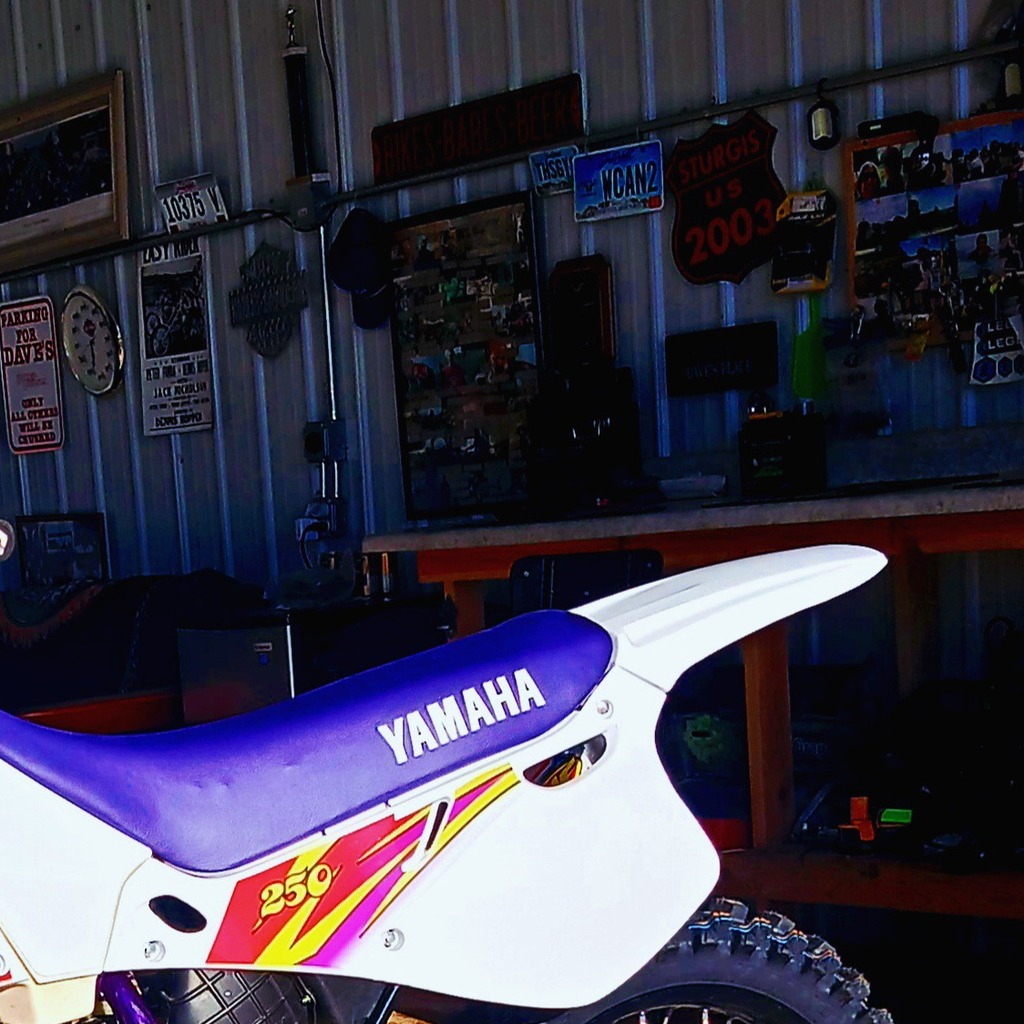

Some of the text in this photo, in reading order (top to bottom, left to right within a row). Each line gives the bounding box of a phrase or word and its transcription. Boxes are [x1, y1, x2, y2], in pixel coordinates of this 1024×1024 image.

[678, 127, 761, 186] STURGIS
[705, 176, 744, 208] US
[163, 191, 205, 223] 10375
[685, 198, 776, 266] 2003
[0, 306, 49, 328] PARKING
[16, 328, 37, 343] FOR
[3, 340, 55, 367] DAVE'S
[11, 411, 25, 422] ALL
[22, 397, 43, 408] ONLY
[19, 422, 40, 433] WILL
[377, 668, 546, 765] YAMAHA
[261, 863, 333, 919] 250
